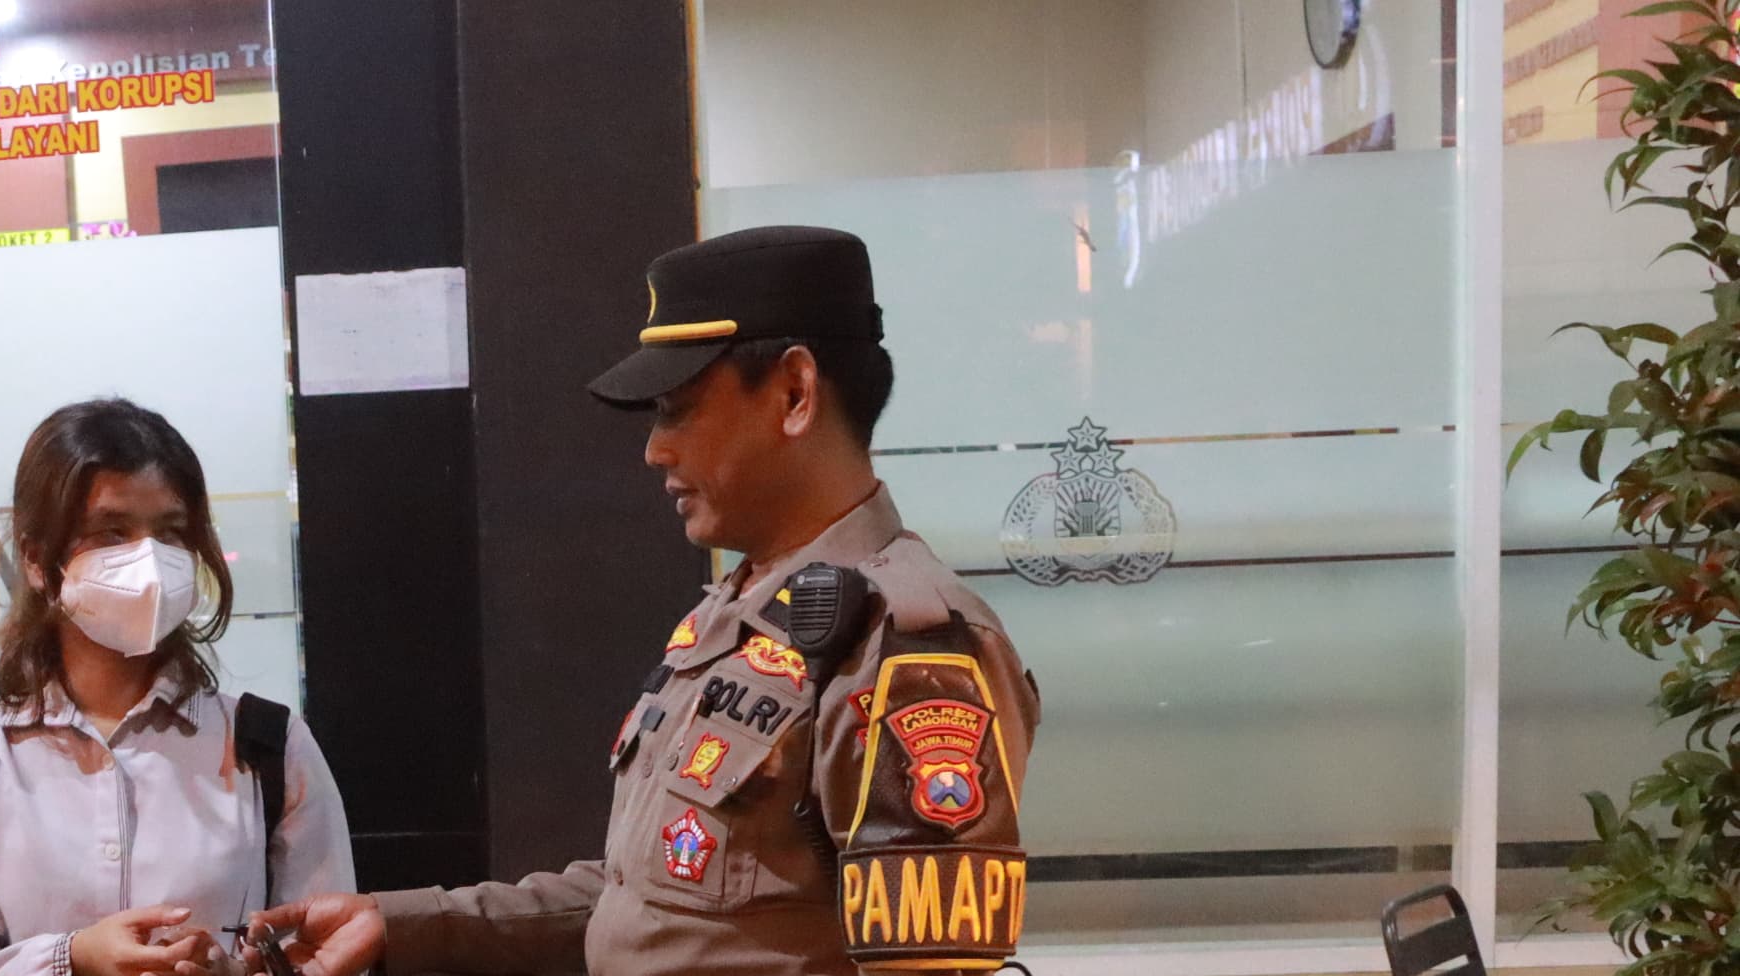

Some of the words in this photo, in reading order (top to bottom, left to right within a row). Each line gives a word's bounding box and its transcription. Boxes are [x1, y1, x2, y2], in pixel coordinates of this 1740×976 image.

[75, 69, 215, 112] KORUPSI
[703, 676, 793, 736] POLRI
[901, 707, 978, 725] POLRES
[903, 716, 978, 733] LAMONGAN
[915, 736, 942, 750] JAWA
[943, 735, 974, 749] TIMUR
